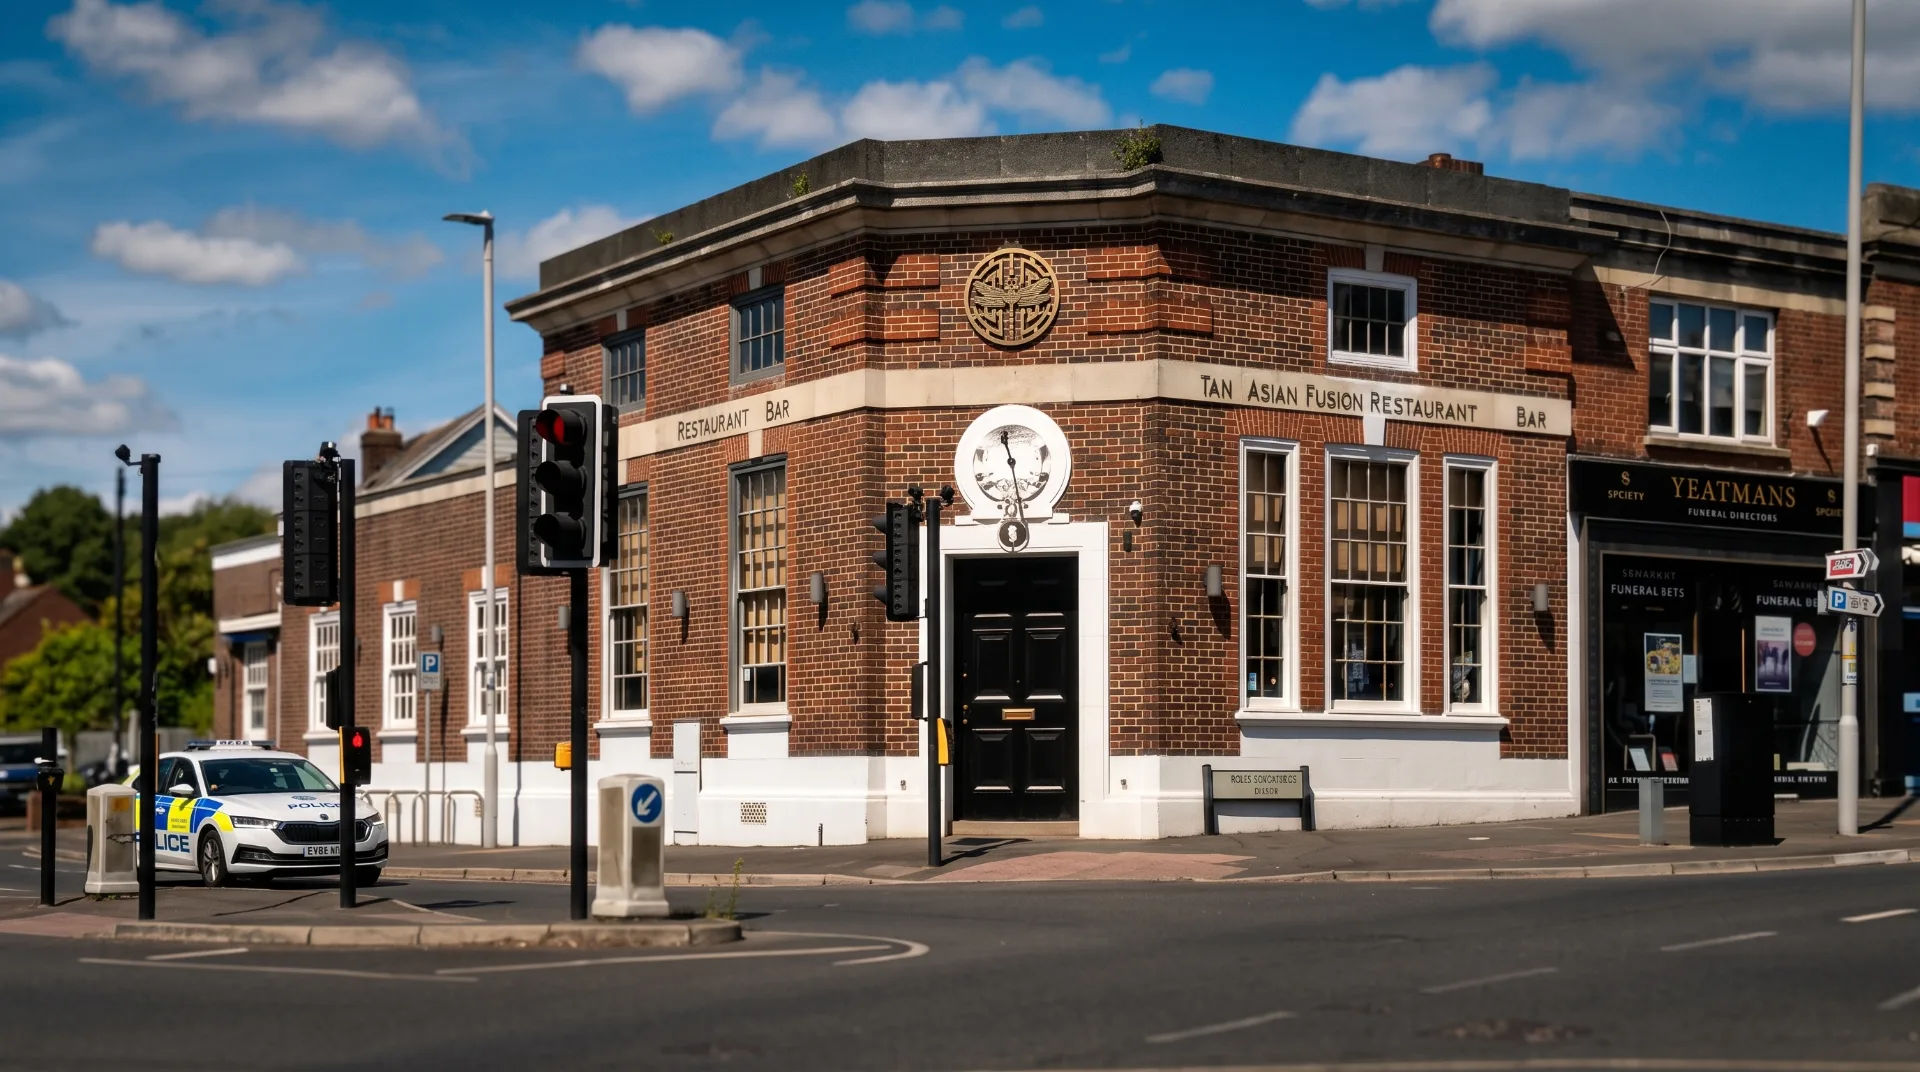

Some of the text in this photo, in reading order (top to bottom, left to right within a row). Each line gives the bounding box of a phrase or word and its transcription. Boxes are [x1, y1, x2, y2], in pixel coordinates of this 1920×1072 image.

[1201, 374, 1547, 429] TAN ASIAN FUSION RESTAURANT BAR
[677, 399, 790, 441] RESTAURANT BAR
[1671, 476, 1796, 508] YEATMANS
[1688, 507, 1778, 523] FUNERAL DIRECTORS
[1611, 583, 1685, 598] FUNERAL BETS
[1756, 595, 1802, 608] FUNERAL
[1834, 592, 1844, 608] P
[425, 655, 437, 672] P
